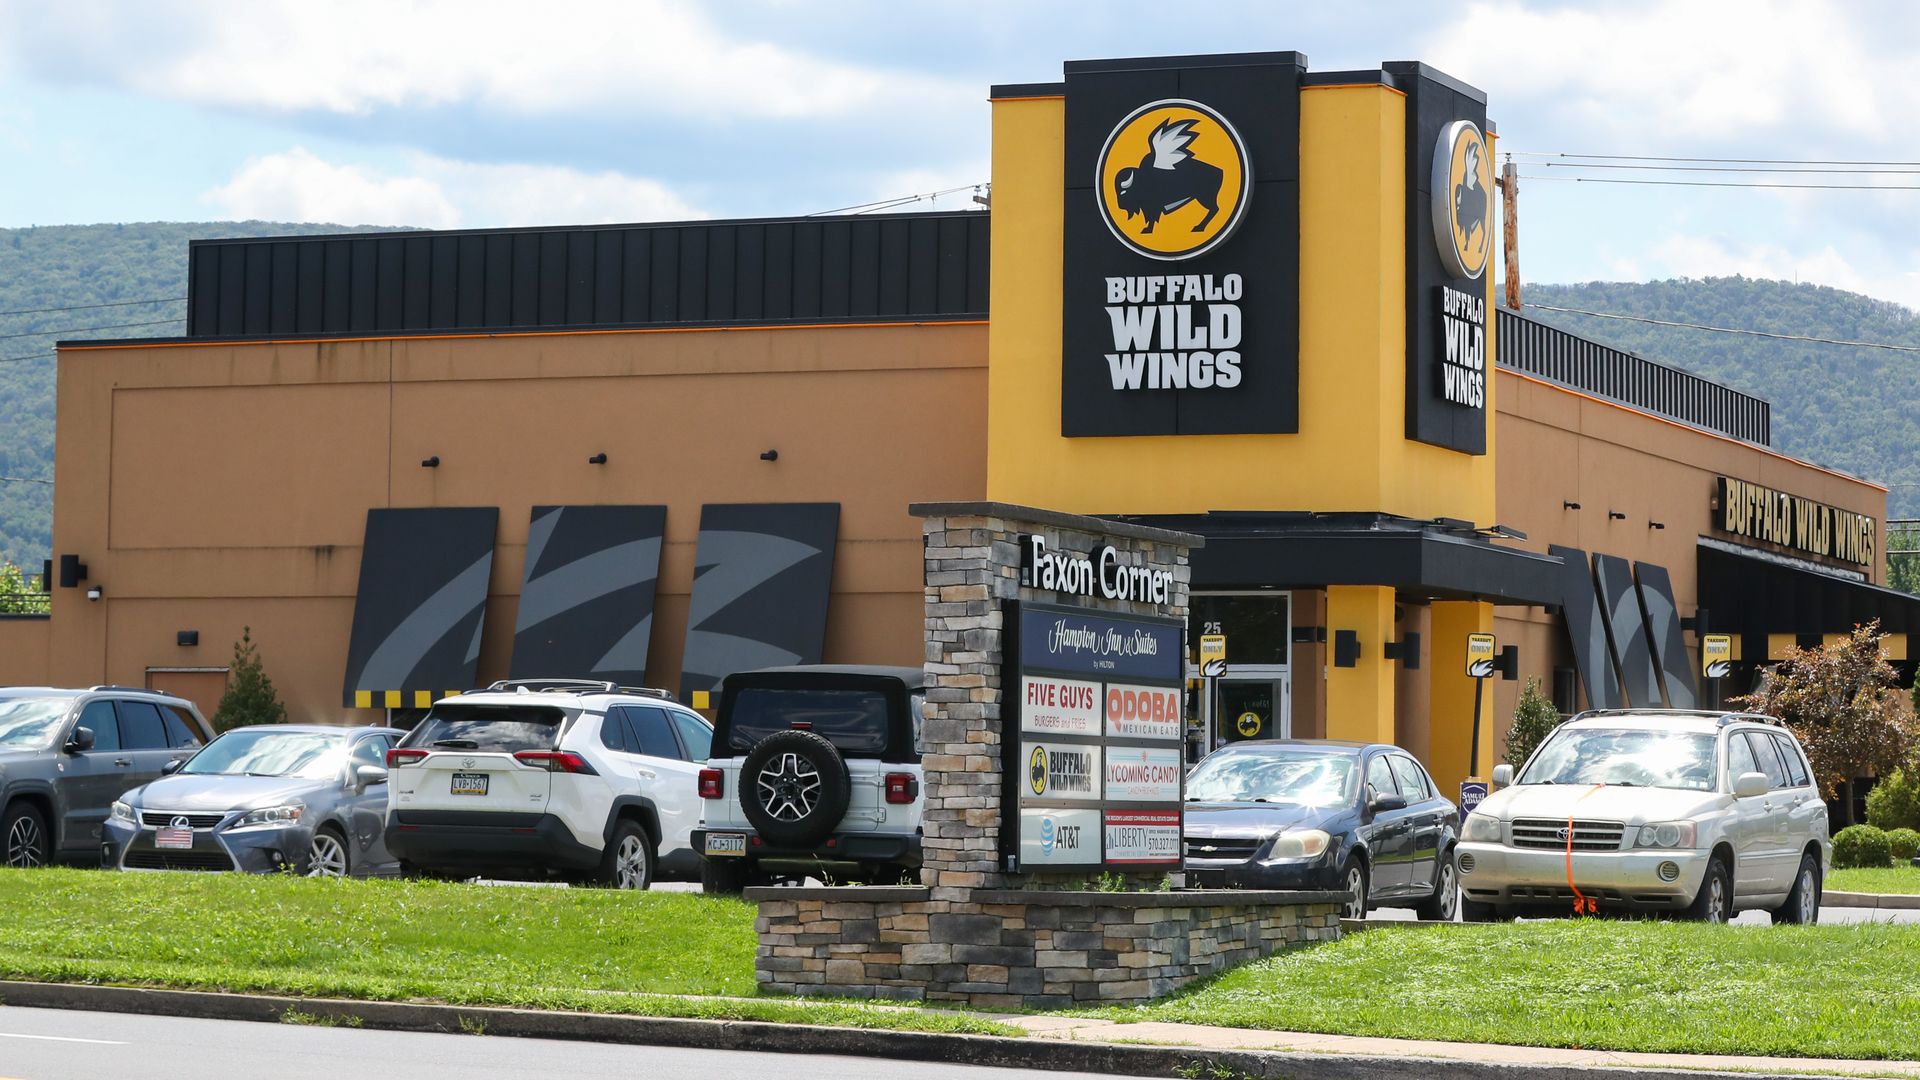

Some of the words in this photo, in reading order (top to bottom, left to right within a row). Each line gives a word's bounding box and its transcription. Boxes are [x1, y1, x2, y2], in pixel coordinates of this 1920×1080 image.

[1105, 273, 1243, 303] BUFFALO
[1443, 286, 1483, 325] BUFFALO
[1104, 304, 1242, 351] WILD
[1443, 314, 1484, 371] WILD
[1104, 350, 1242, 390] WINGS
[1443, 362, 1483, 409] WINGS
[1724, 477, 1791, 546] BUFFALO
[1795, 498, 1830, 556] WILD
[1834, 508, 1875, 566] WINGS
[1031, 534, 1094, 596] Faxon
[1100, 545, 1173, 605] Corner
[1048, 618, 1101, 655] Hampton
[1100, 627, 1128, 656] Inn
[1130, 628, 1157, 656] Suites
[1203, 621, 1221, 634] 25
[1203, 645, 1223, 653] ONLY
[1471, 645, 1491, 653] ONLY
[1706, 646, 1728, 654] ONLY
[1027, 682, 1056, 707] FIVE
[1060, 685, 1093, 710] GUYS
[1107, 688, 1179, 733] QDOBA
[1122, 723, 1158, 736] MEXICAN
[1160, 725, 1179, 736] EATS
[1049, 751, 1092, 775] BUFFALO
[1107, 764, 1150, 783] LYCOMING
[1151, 765, 1179, 783] CANDY
[1049, 774, 1068, 791] WILD
[1068, 774, 1092, 792] WINGS
[1462, 791, 1485, 800] SAMUEL
[1055, 826, 1081, 849] AT&T
[1114, 827, 1148, 848] LIBERTY
